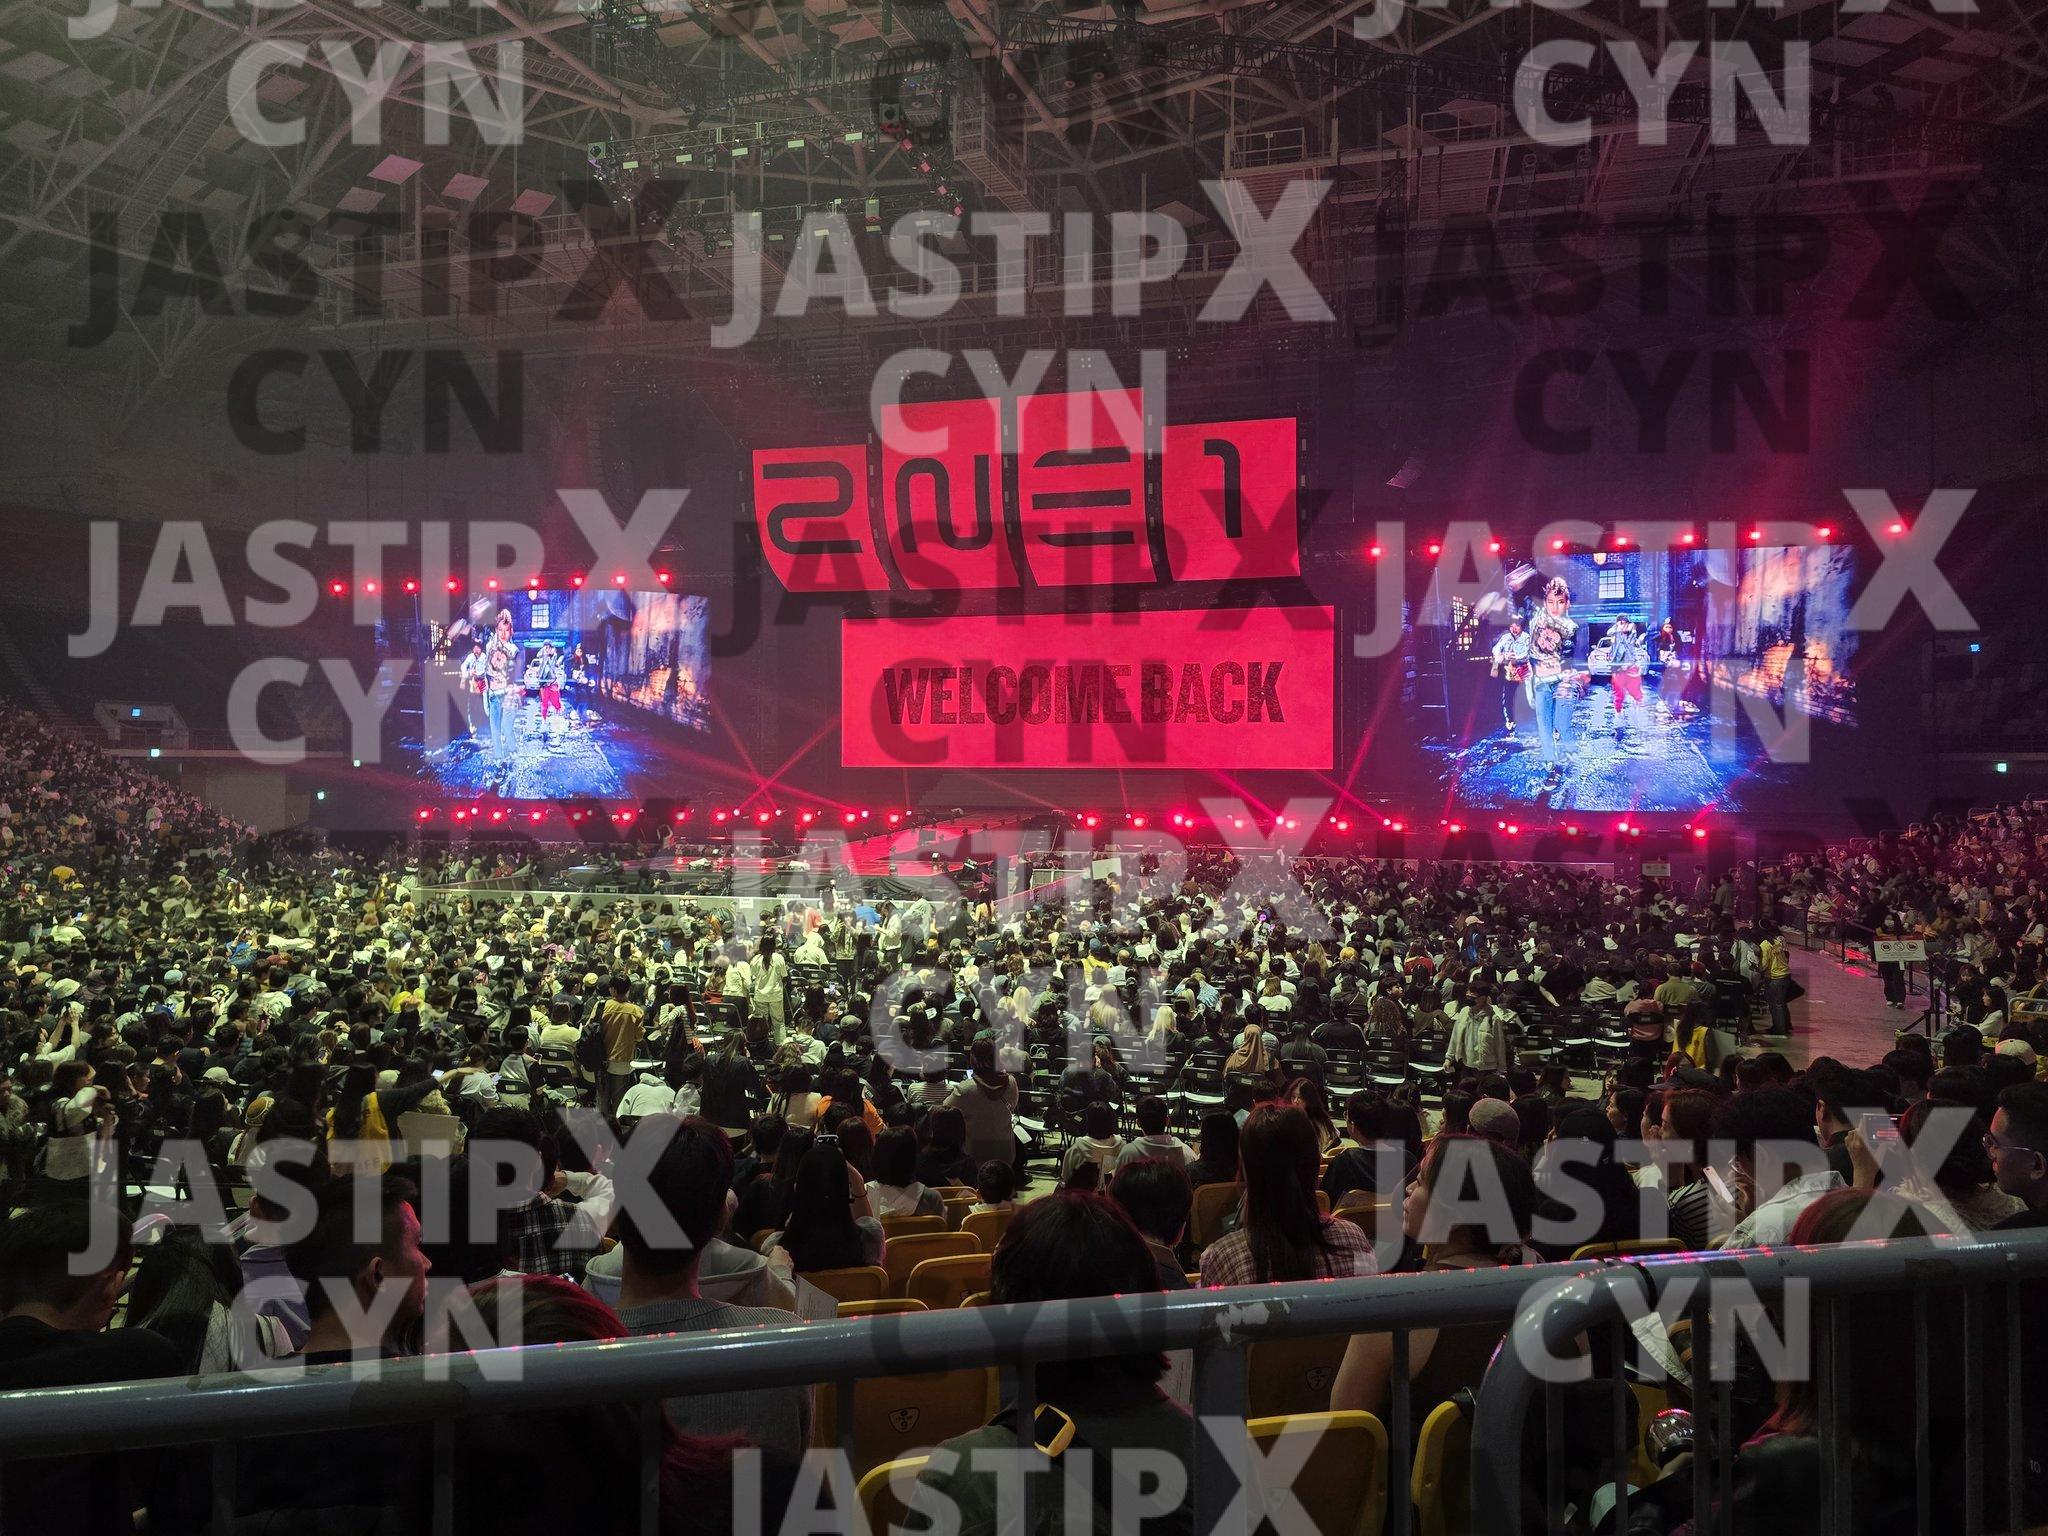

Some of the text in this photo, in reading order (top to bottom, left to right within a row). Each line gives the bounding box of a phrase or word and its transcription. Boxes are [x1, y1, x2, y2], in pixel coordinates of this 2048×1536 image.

[762, 438, 1242, 554] 2NE1
[882, 661, 1285, 725] WELCOME BACK
